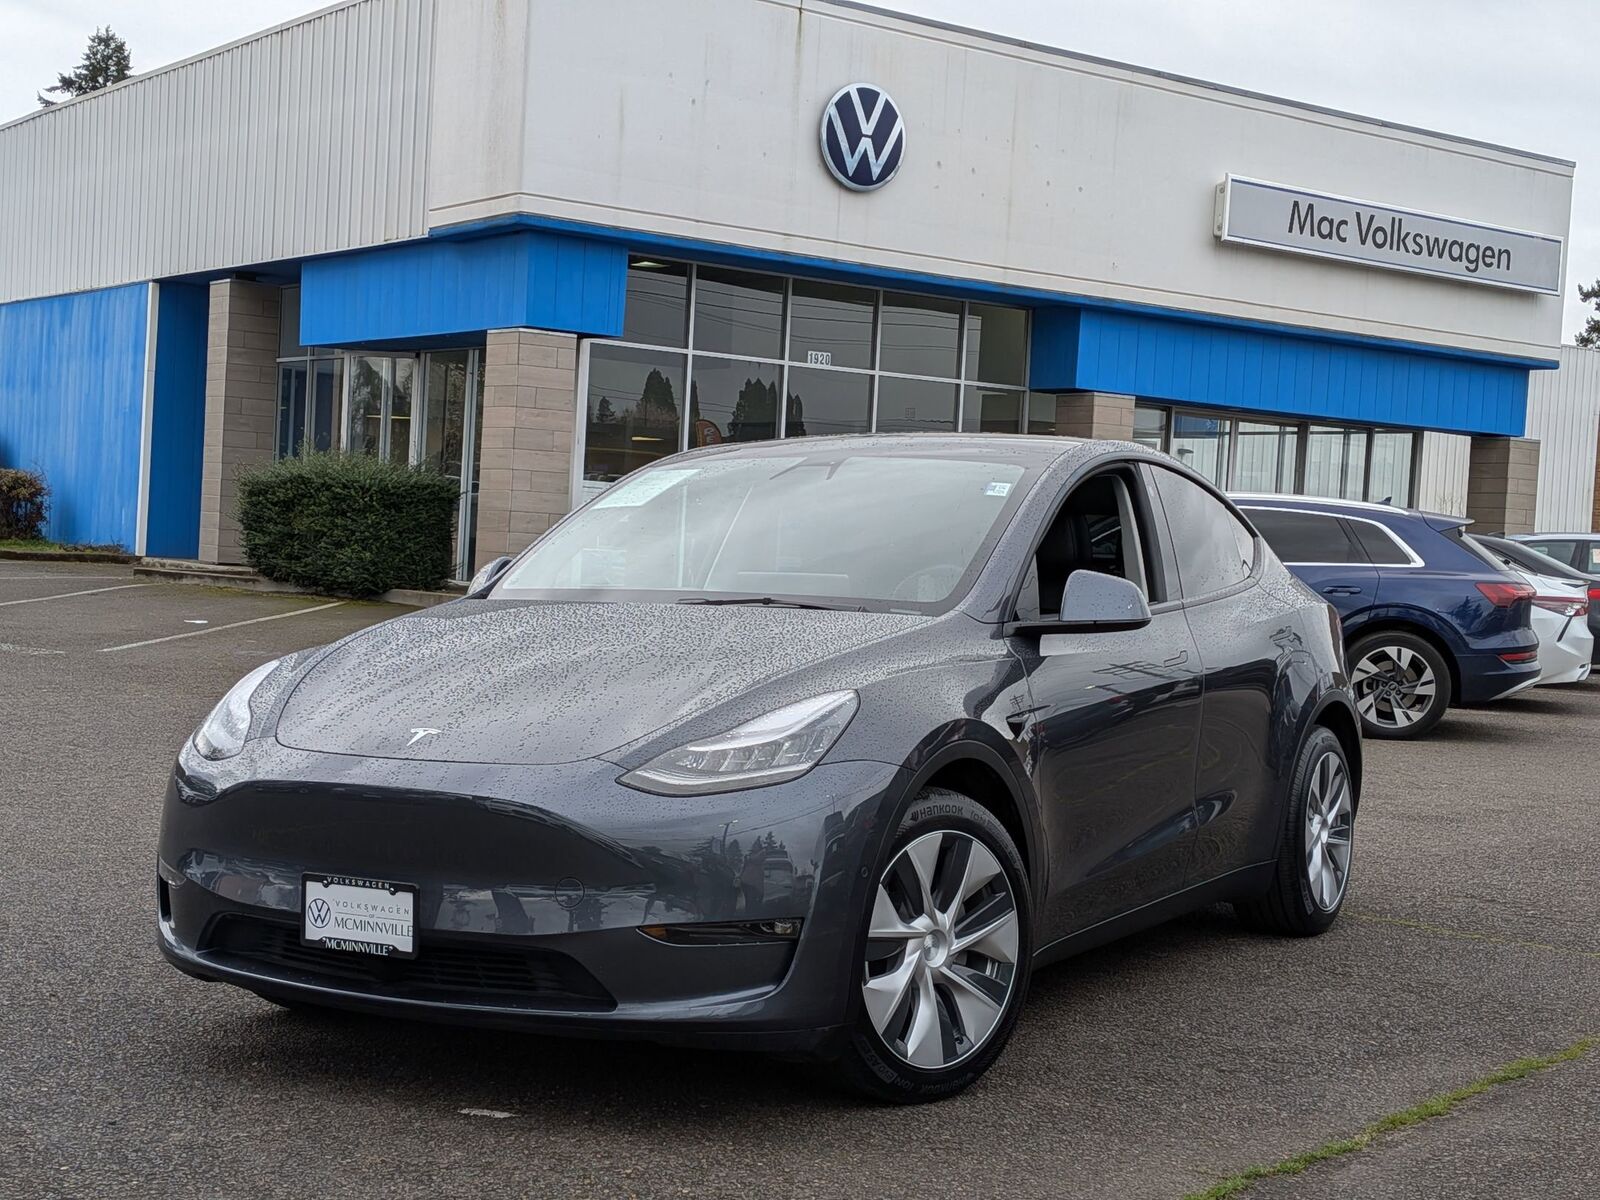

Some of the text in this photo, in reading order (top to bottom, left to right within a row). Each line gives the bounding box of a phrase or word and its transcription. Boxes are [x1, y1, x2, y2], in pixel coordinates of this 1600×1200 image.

[1288, 200, 1512, 273] Mac Volkswagen
[809, 352, 830, 365] 1920
[326, 876, 390, 889] VOLKSWAGEN
[335, 900, 410, 915] VOLKSWAGEN
[334, 916, 413, 937] MCMINNVILLE
[325, 939, 389, 956] MCMINNVILLE
